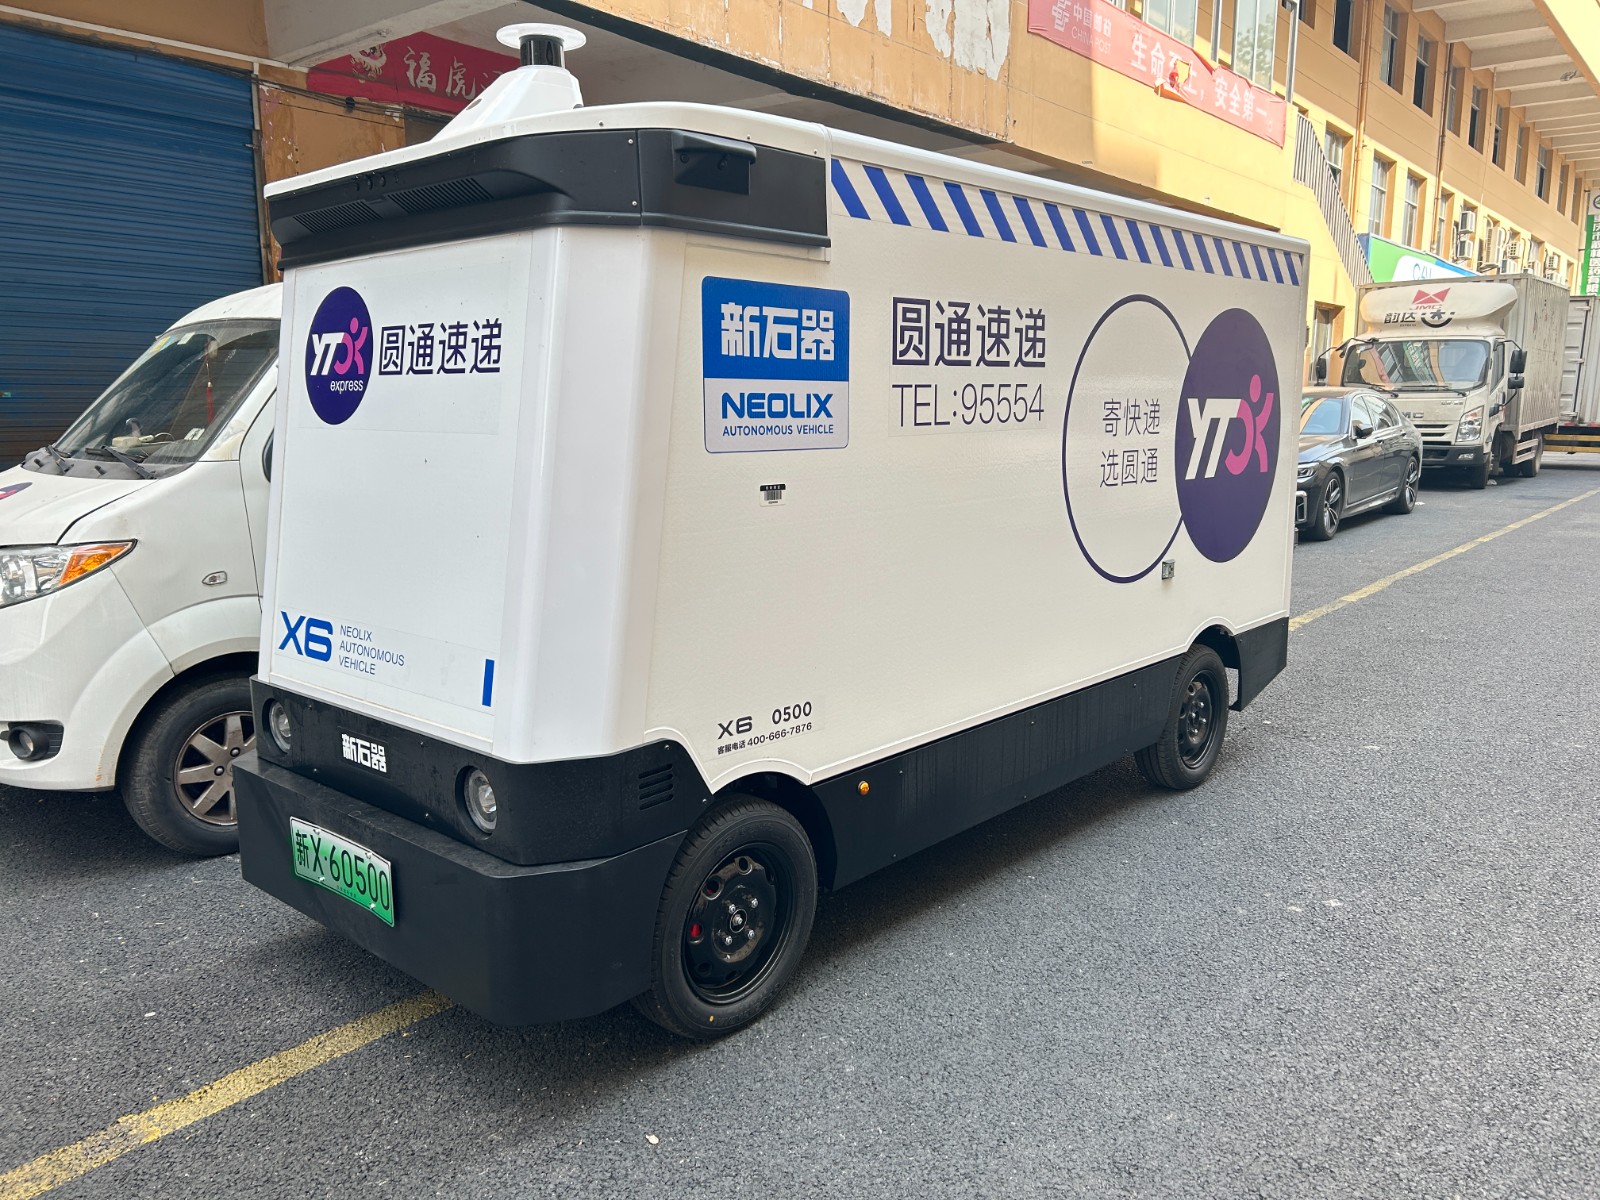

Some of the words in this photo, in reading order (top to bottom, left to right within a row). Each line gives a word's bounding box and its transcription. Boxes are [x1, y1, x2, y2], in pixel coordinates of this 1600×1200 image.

[1071, 25, 1094, 47] CHINA
[404, 46, 503, 100] 福虎
[720, 301, 835, 361] 新石器
[892, 296, 1046, 368] 圆通速递
[1384, 312, 1418, 324] 韵达
[379, 318, 502, 376] 圆通速递
[330, 379, 364, 394] express
[721, 392, 834, 419] NEOLIX
[891, 383, 1045, 428] TEL:95554
[722, 425, 793, 437] AUTONOMOUS
[796, 424, 834, 435] VEHICLE
[1102, 397, 1161, 437] 寄快递
[1099, 448, 1158, 488] 选圆通
[278, 610, 333, 663] X6
[339, 624, 373, 643] NEOLIX
[338, 654, 376, 676] VEHICLE
[339, 640, 405, 667] AUTONOMOUS
[717, 715, 753, 740] X6
[771, 701, 812, 725] 0500
[717, 740, 746, 755] 客服电话
[746, 722, 812, 747] 400-666-7876
[341, 733, 388, 773] 新石器
